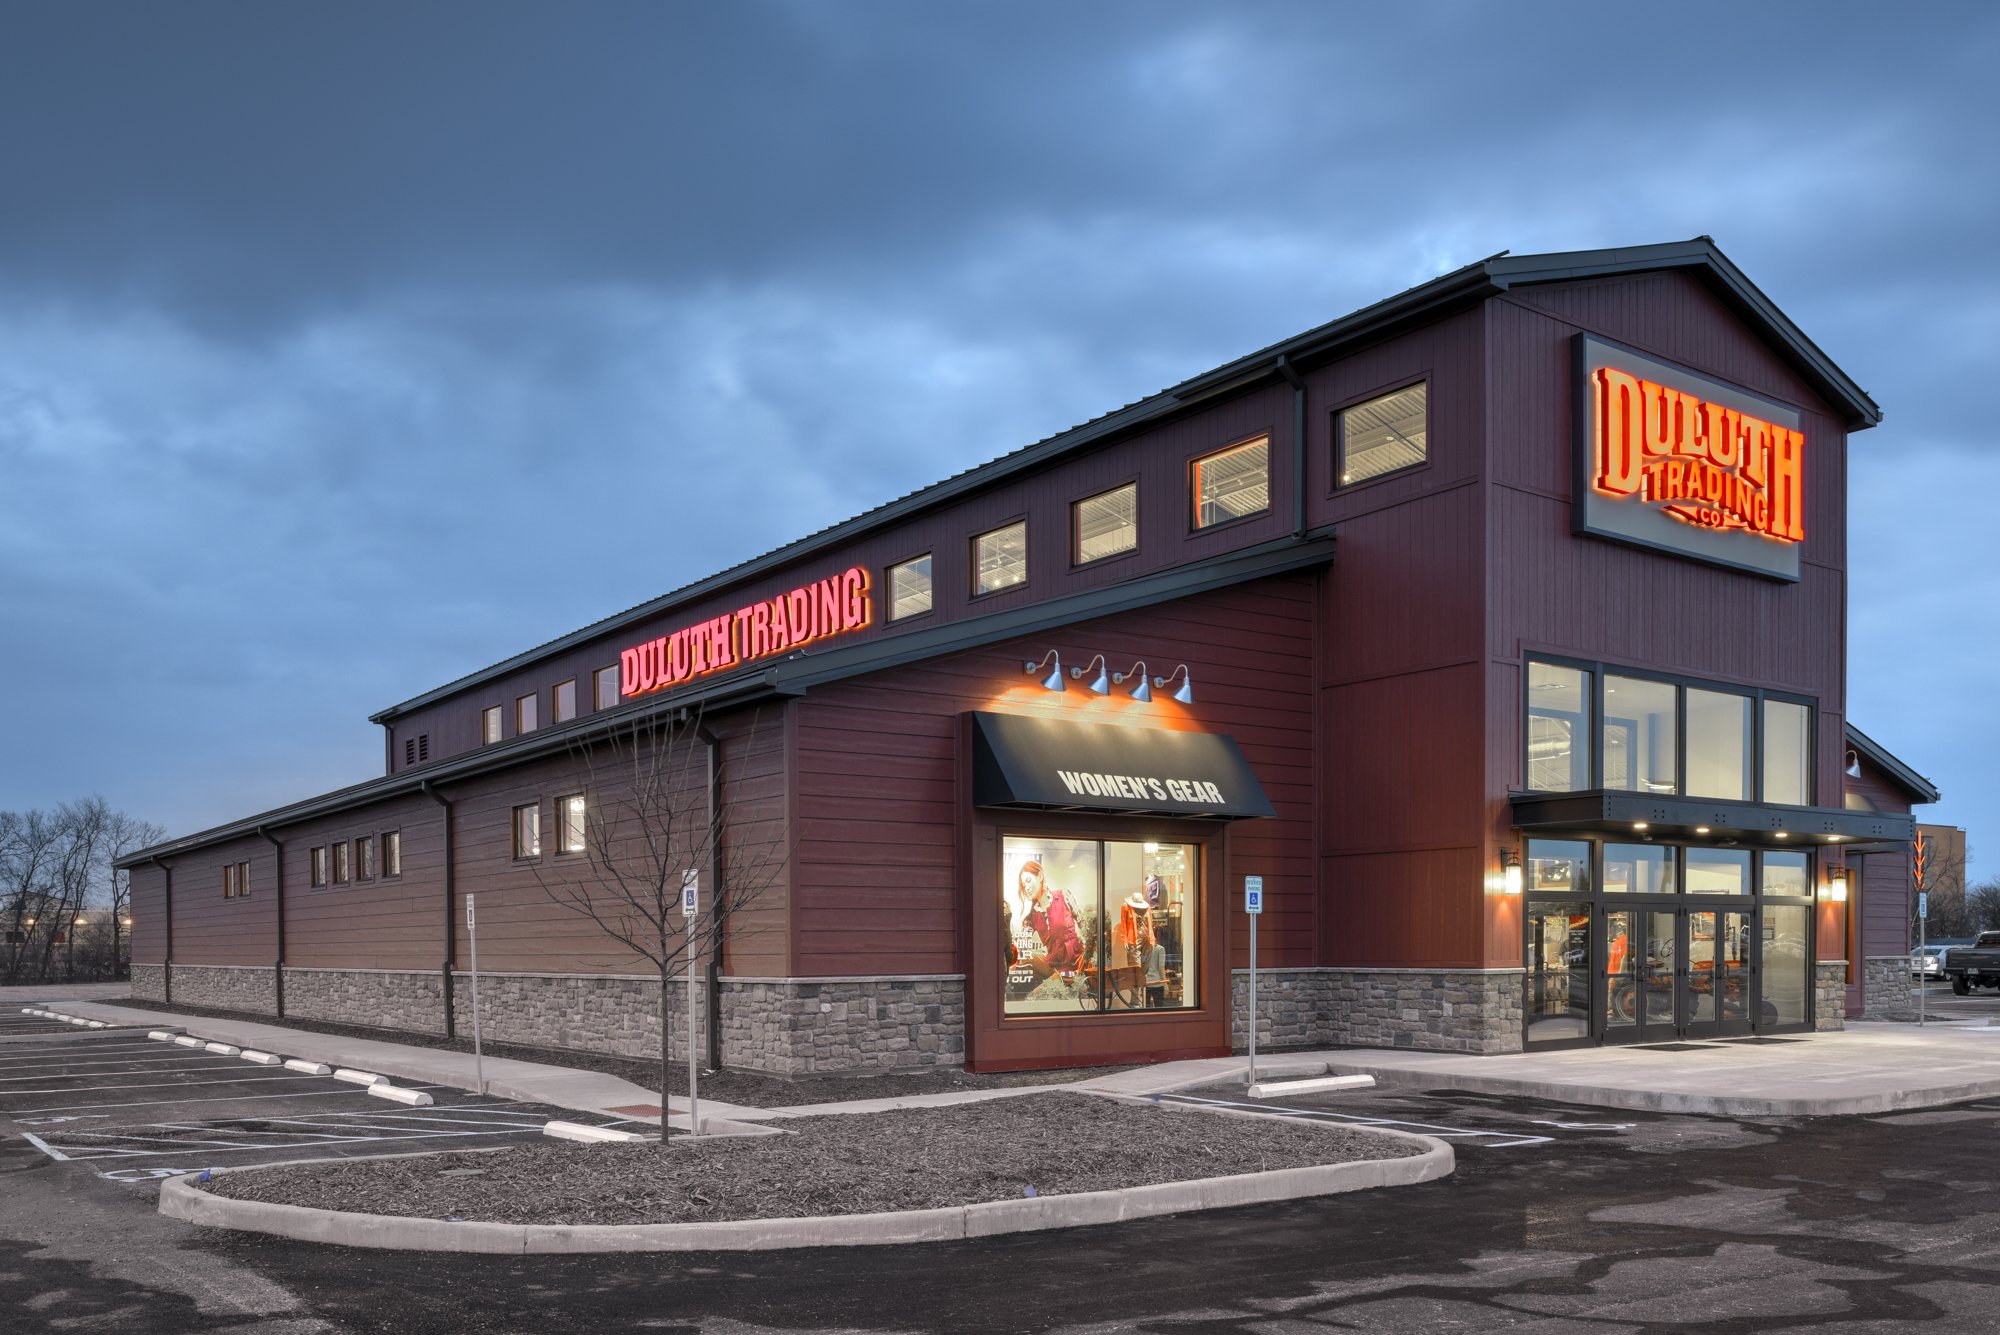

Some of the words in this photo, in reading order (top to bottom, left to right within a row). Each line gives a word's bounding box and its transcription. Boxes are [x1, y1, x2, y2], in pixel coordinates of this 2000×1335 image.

[1595, 367, 1804, 542] DULUTH
[1648, 460, 1768, 530] TRADING
[621, 614, 736, 696] DULUTH
[737, 568, 867, 660] TRADING
[1057, 770, 1168, 801] WOMEN'S
[1165, 778, 1226, 804] GEAR
[1011, 975, 1033, 983] OUT
